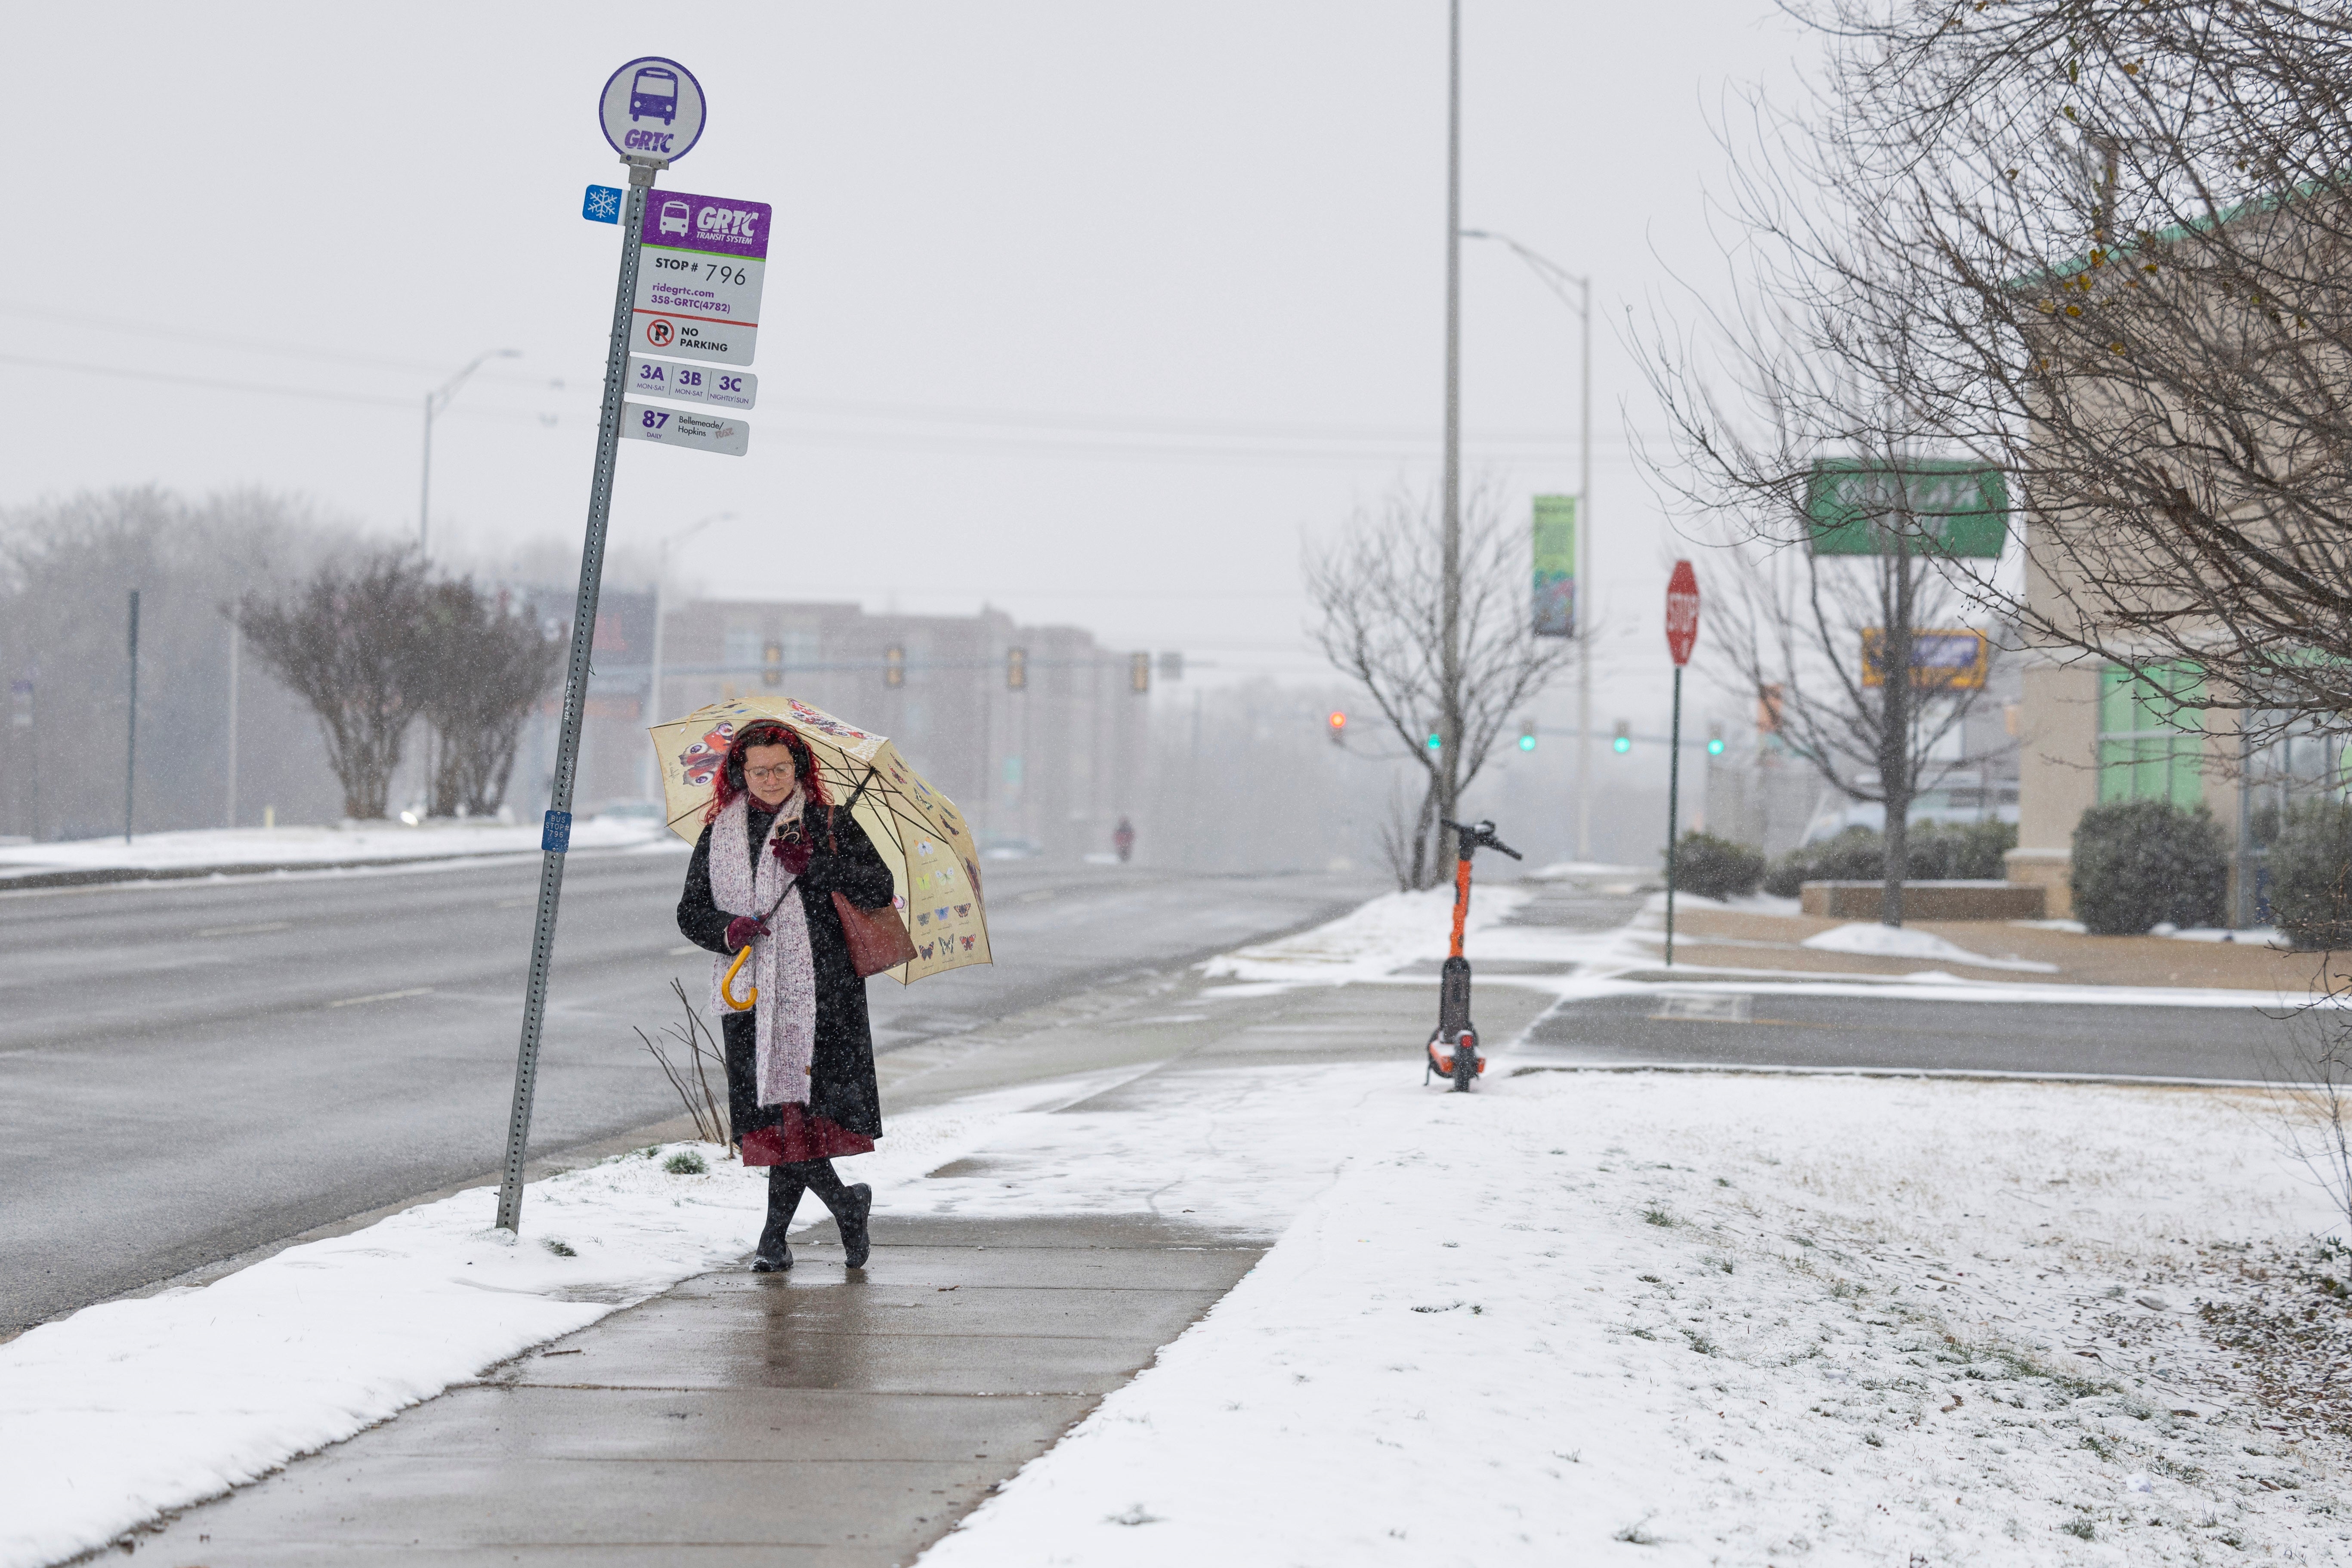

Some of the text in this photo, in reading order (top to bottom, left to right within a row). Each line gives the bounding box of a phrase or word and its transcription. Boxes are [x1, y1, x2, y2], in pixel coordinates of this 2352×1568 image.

[624, 129, 674, 153] GRTC
[697, 207, 759, 237] GRTC
[696, 231, 752, 245] TRANSIT SYSTEM
[655, 258, 689, 271] STOP
[706, 264, 745, 285] 796
[652, 283, 714, 298] ridegrtc.com
[651, 295, 730, 314] 358-GRTC(4782)
[681, 327, 698, 337] NO
[680, 338, 728, 352] PARKING
[640, 365, 742, 392] 3A 3B 3C
[637, 383, 665, 392] MON-SAT
[675, 388, 703, 397] MON-SAT
[642, 410, 670, 429] 87
[679, 416, 724, 430] Bellemeade/
[678, 426, 706, 436] Hopkins
